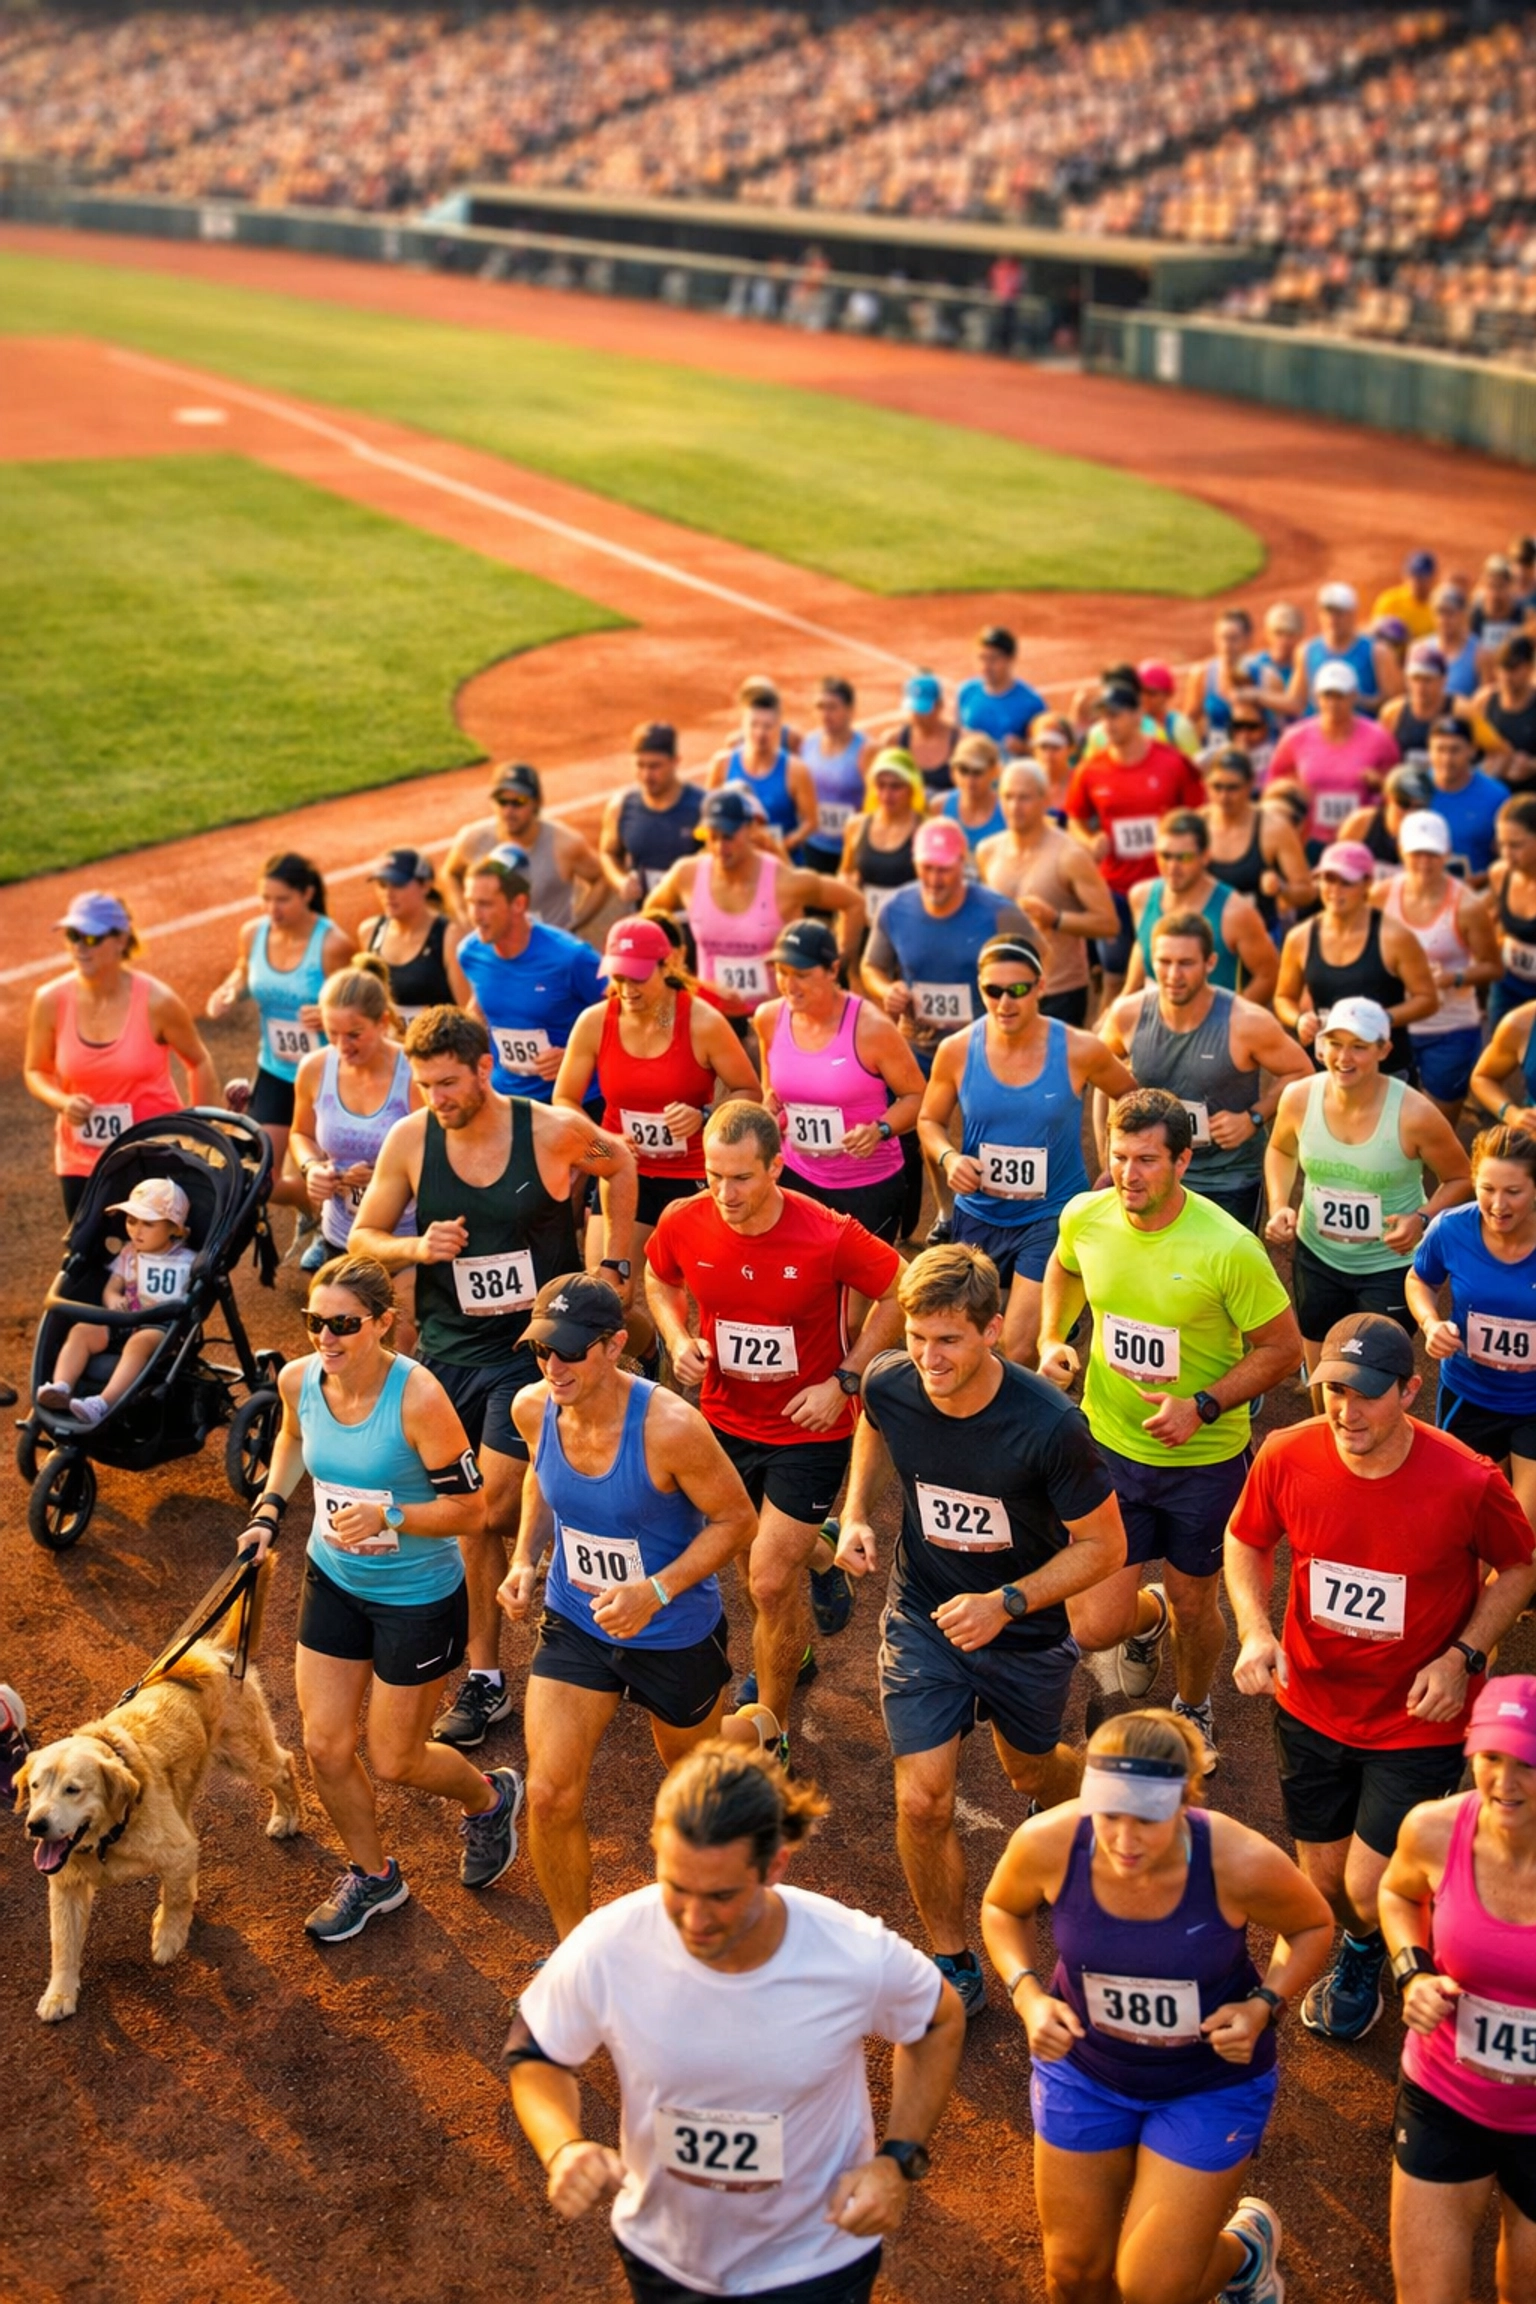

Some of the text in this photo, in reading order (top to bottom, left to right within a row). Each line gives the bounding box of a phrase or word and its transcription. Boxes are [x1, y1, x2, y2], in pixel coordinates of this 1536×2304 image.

[1323, 1201, 1370, 1230] 250
[729, 1334, 782, 1365] 722
[1114, 1329, 1165, 1367] 500
[932, 1499, 994, 1535] 322
[576, 1545, 628, 1582] 810
[1325, 1576, 1387, 1622] 722
[1103, 1987, 1178, 2028] 380
[1474, 2016, 1536, 2064] 145
[674, 2126, 759, 2171] 322
